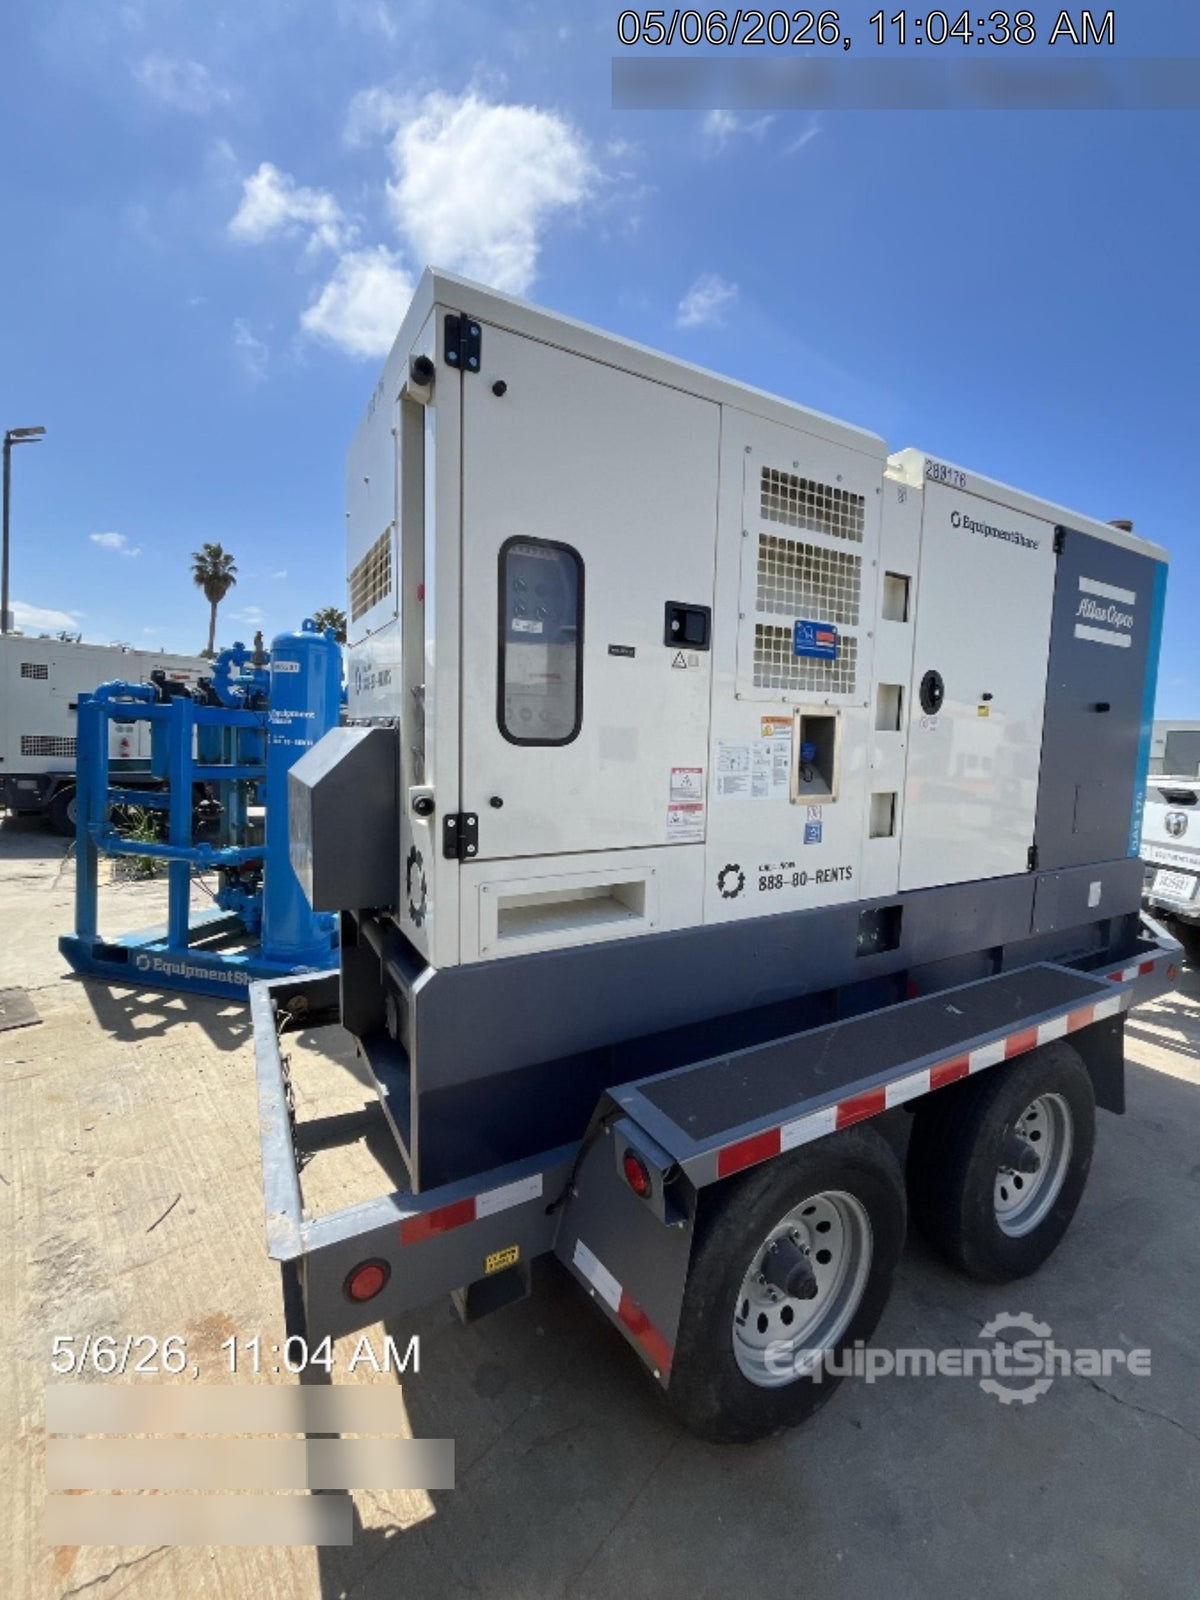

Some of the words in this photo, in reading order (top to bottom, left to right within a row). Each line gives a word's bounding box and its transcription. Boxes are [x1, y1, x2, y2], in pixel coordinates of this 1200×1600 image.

[962, 515, 1040, 550] EquipmentShare
[1075, 598, 1107, 621] Atlas
[1107, 604, 1134, 628] Copco
[758, 866, 853, 891] 888-80-RENTS
